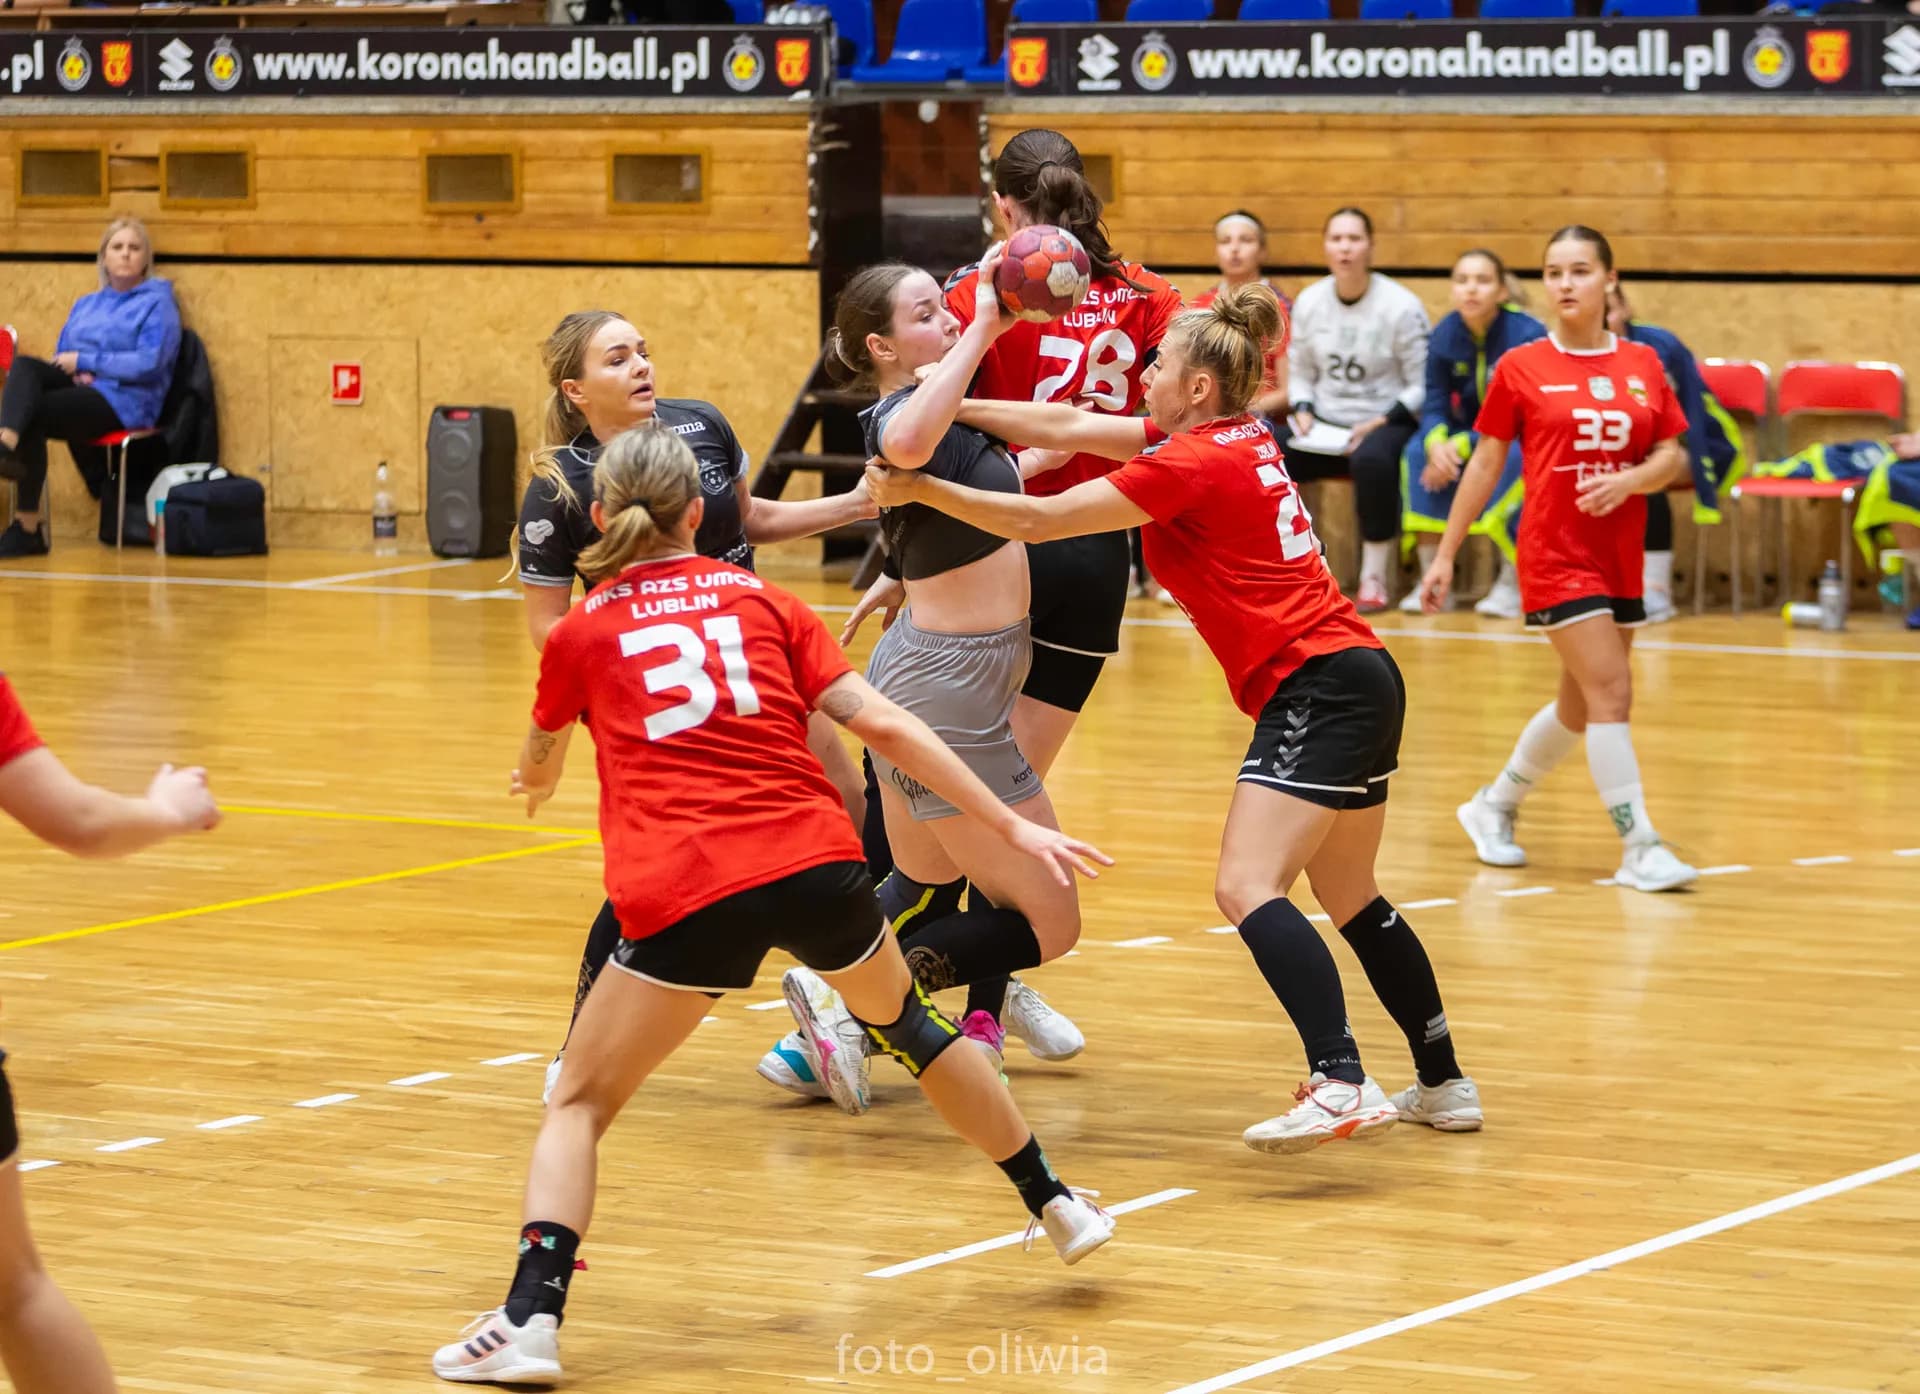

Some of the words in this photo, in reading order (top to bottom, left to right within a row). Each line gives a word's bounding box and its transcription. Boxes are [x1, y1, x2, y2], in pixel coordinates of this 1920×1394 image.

[253, 38, 709, 92] www.koronahandball.pl
[1188, 30, 1729, 90] www.koronahandball.pl
[1328, 354, 1365, 382] 26
[672, 421, 706, 435] oma
[1572, 408, 1632, 451] 33
[585, 583, 633, 613] MKS
[640, 576, 689, 595] AZS
[631, 593, 719, 620] LUBLIN
[618, 615, 761, 741] 31
